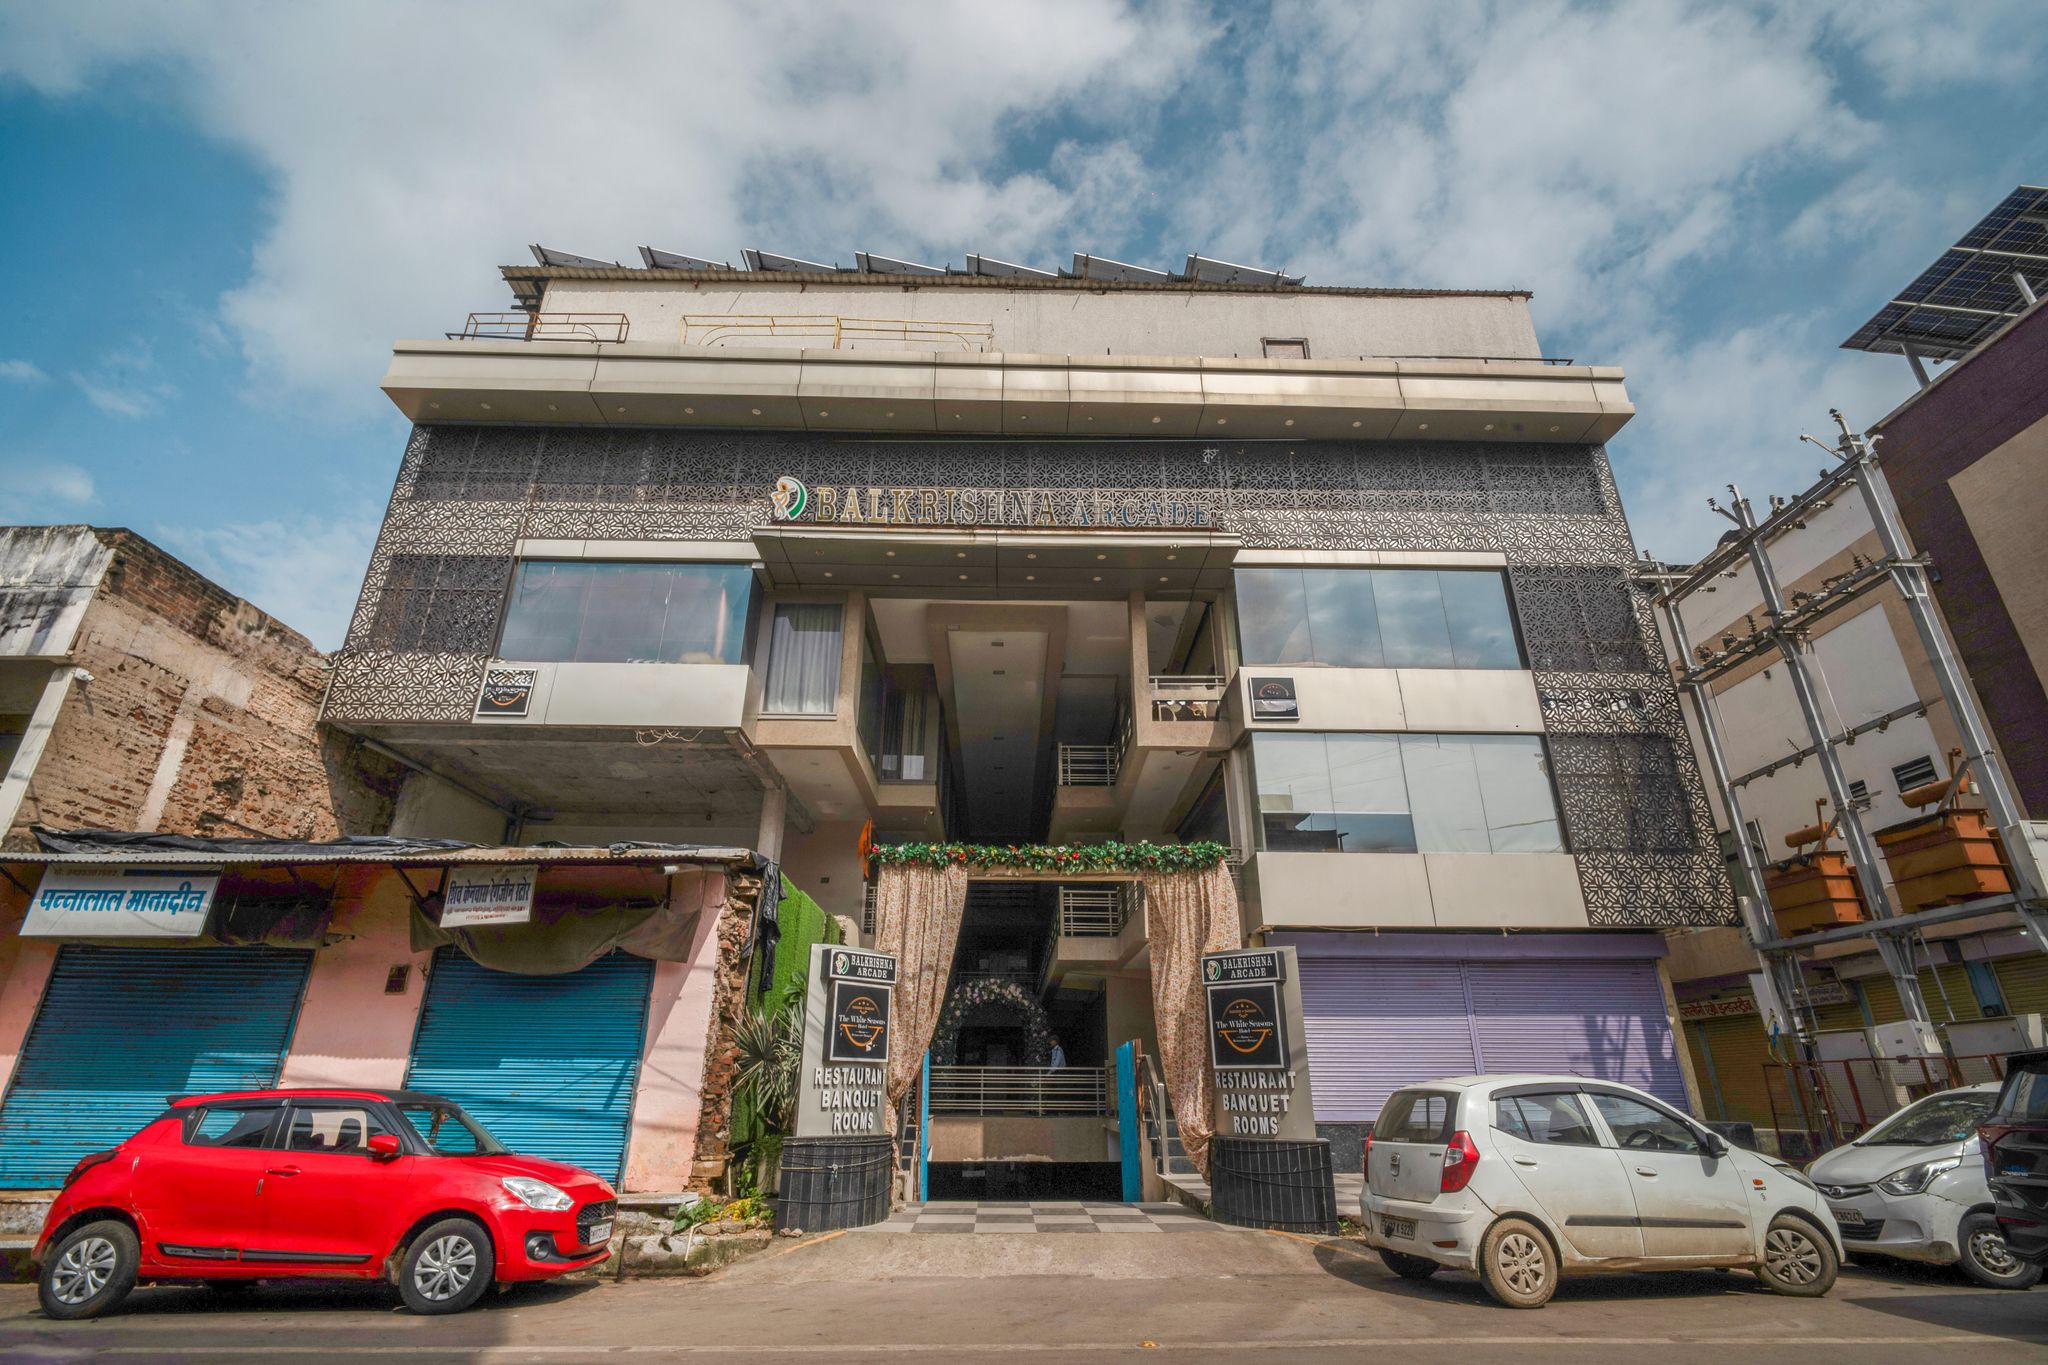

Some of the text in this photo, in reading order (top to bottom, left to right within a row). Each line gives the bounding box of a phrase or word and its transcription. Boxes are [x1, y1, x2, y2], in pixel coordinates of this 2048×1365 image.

[816, 487, 1213, 528] BALKRISHNA ARCADE
[39, 881, 207, 915] पन्नालाल मातादीन
[851, 955, 894, 970] BALKRISHNA
[1222, 955, 1273, 970] BALKRISHNA
[856, 967, 888, 979] ARCADE
[1230, 967, 1266, 979] ARCADE
[838, 1014, 850, 1022] The
[1229, 1019, 1248, 1028] White
[814, 1067, 886, 1086] RESTAURANT
[1215, 1071, 1297, 1090] RESTAURANT
[821, 1090, 882, 1109] BANQUET
[1222, 1094, 1290, 1113] BANQUET
[833, 1112, 874, 1131] ROOMS
[1233, 1116, 1279, 1135] ROOMS
